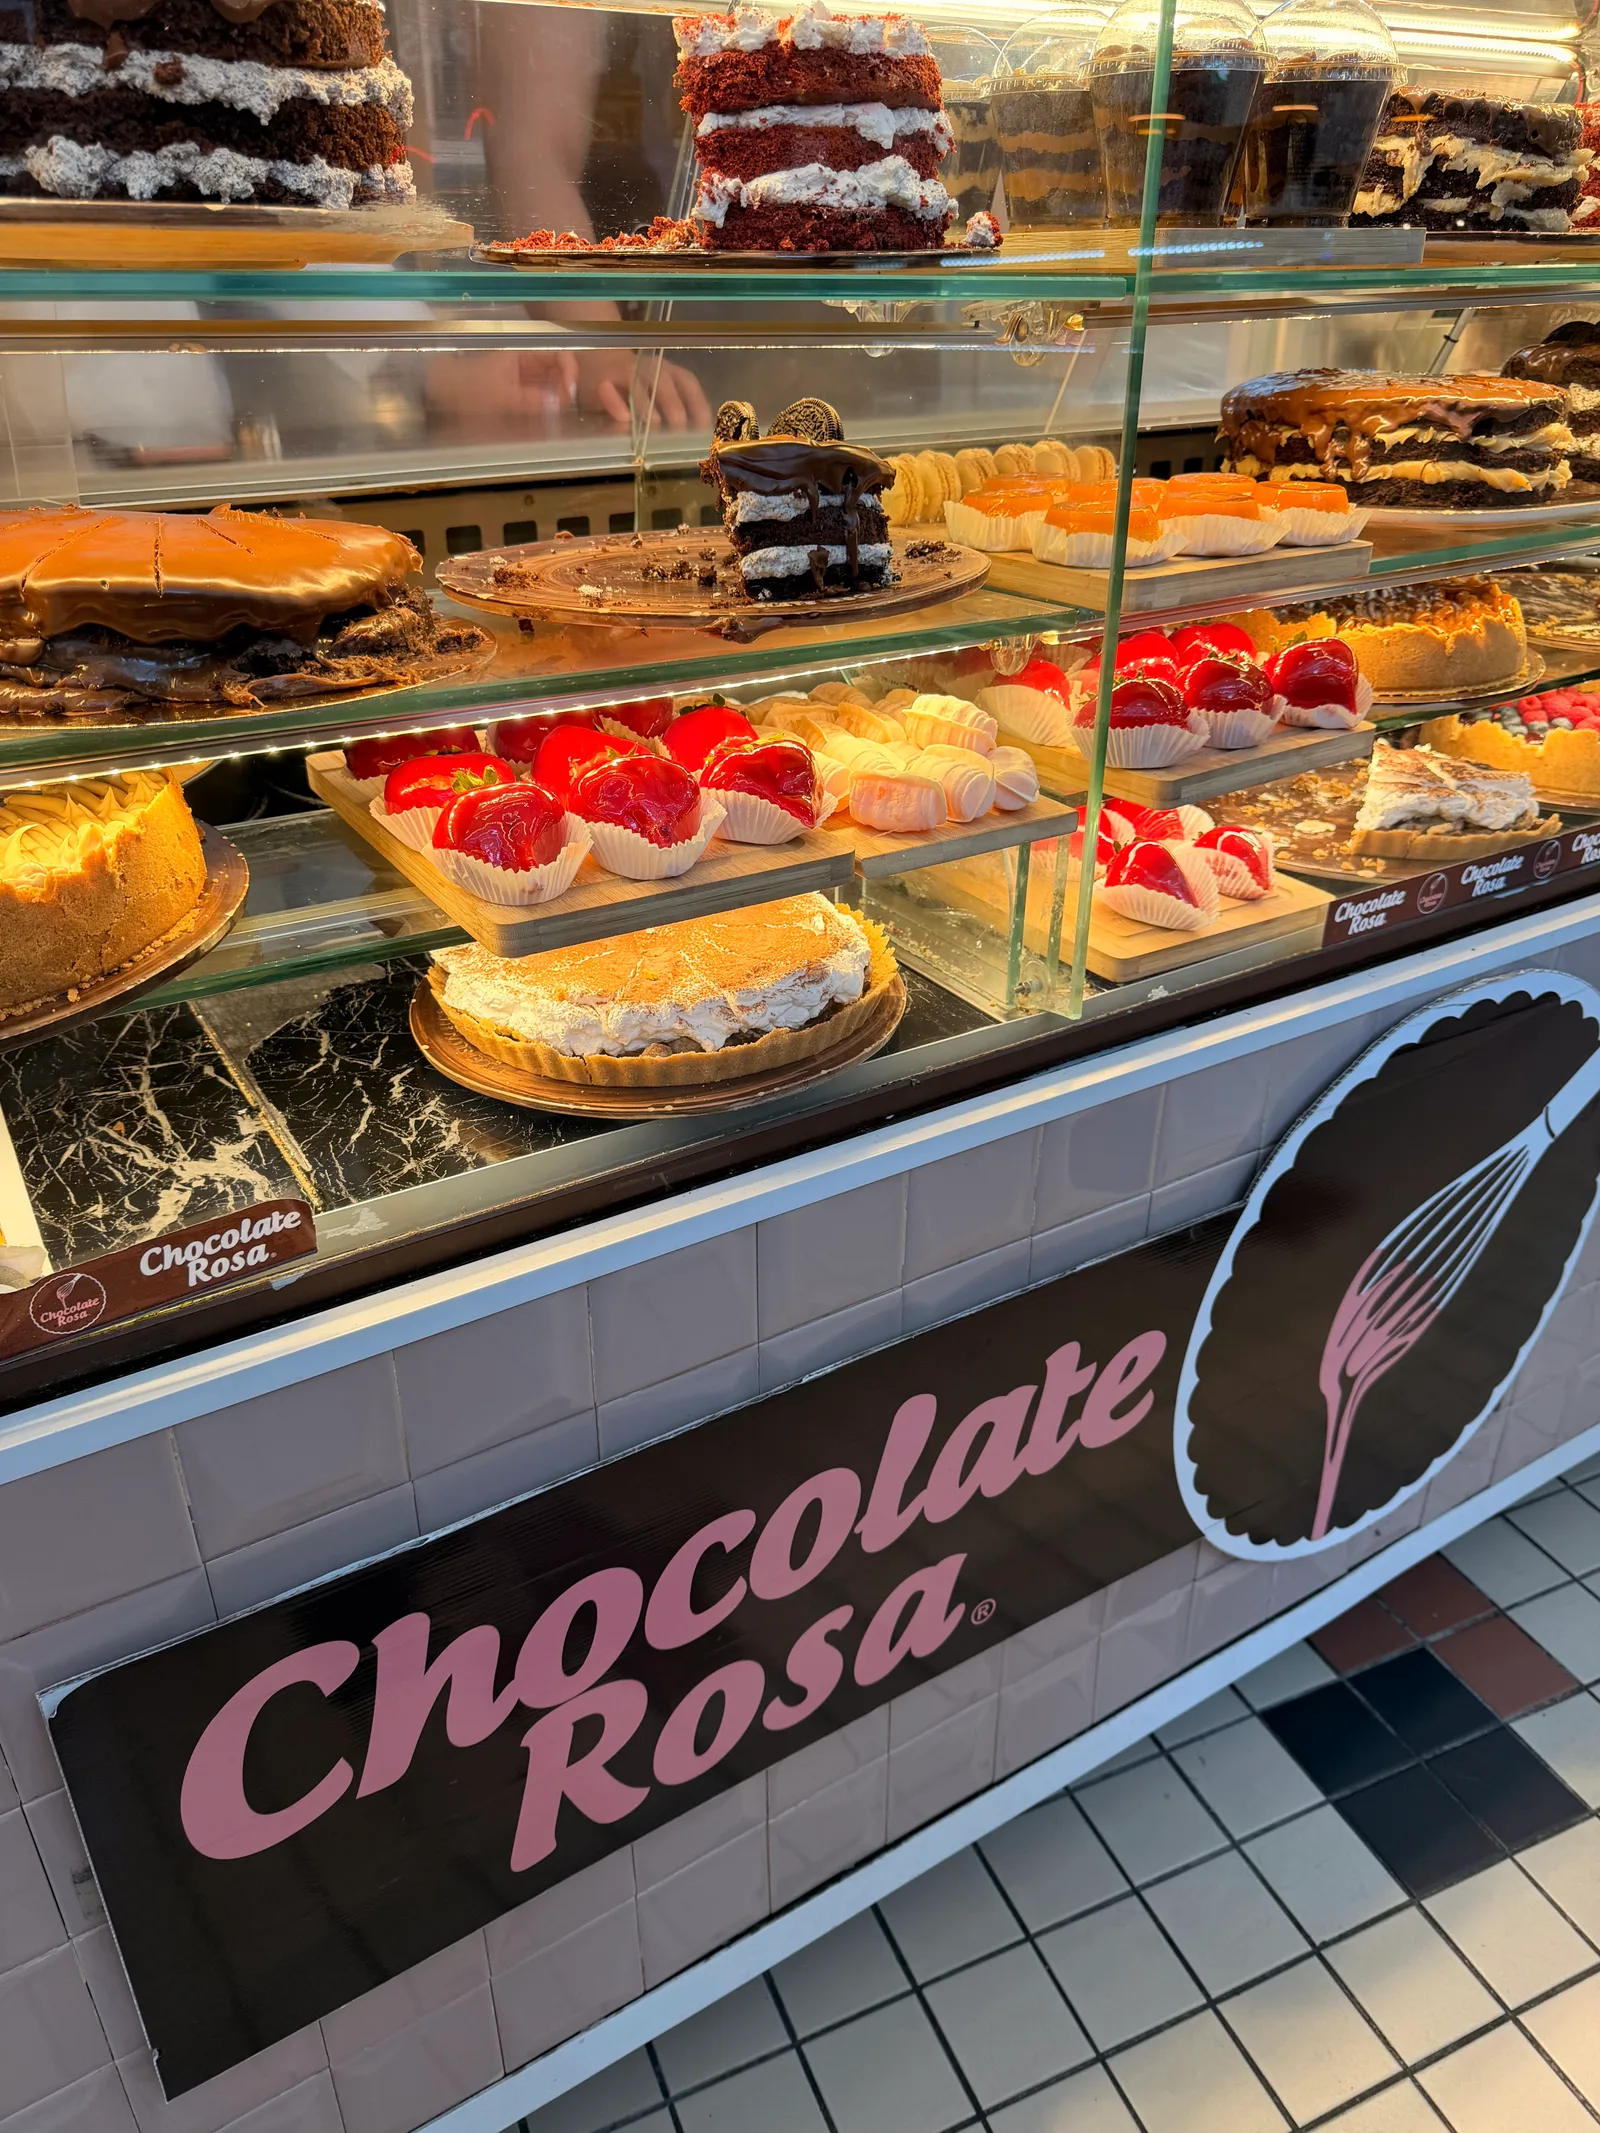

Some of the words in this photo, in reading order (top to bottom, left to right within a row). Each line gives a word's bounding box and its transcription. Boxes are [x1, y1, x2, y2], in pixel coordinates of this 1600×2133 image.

[1461, 855, 1524, 885] Chocolate
[1471, 876, 1507, 897] Rosa
[1334, 890, 1406, 922] Chocolate
[1348, 912, 1387, 935] Rosa
[139, 1211, 301, 1276] Chocolate
[40, 1298, 100, 1323] Chocolate
[57, 1311, 88, 1327] Rosa
[181, 1332, 1166, 1860] Chocolate
